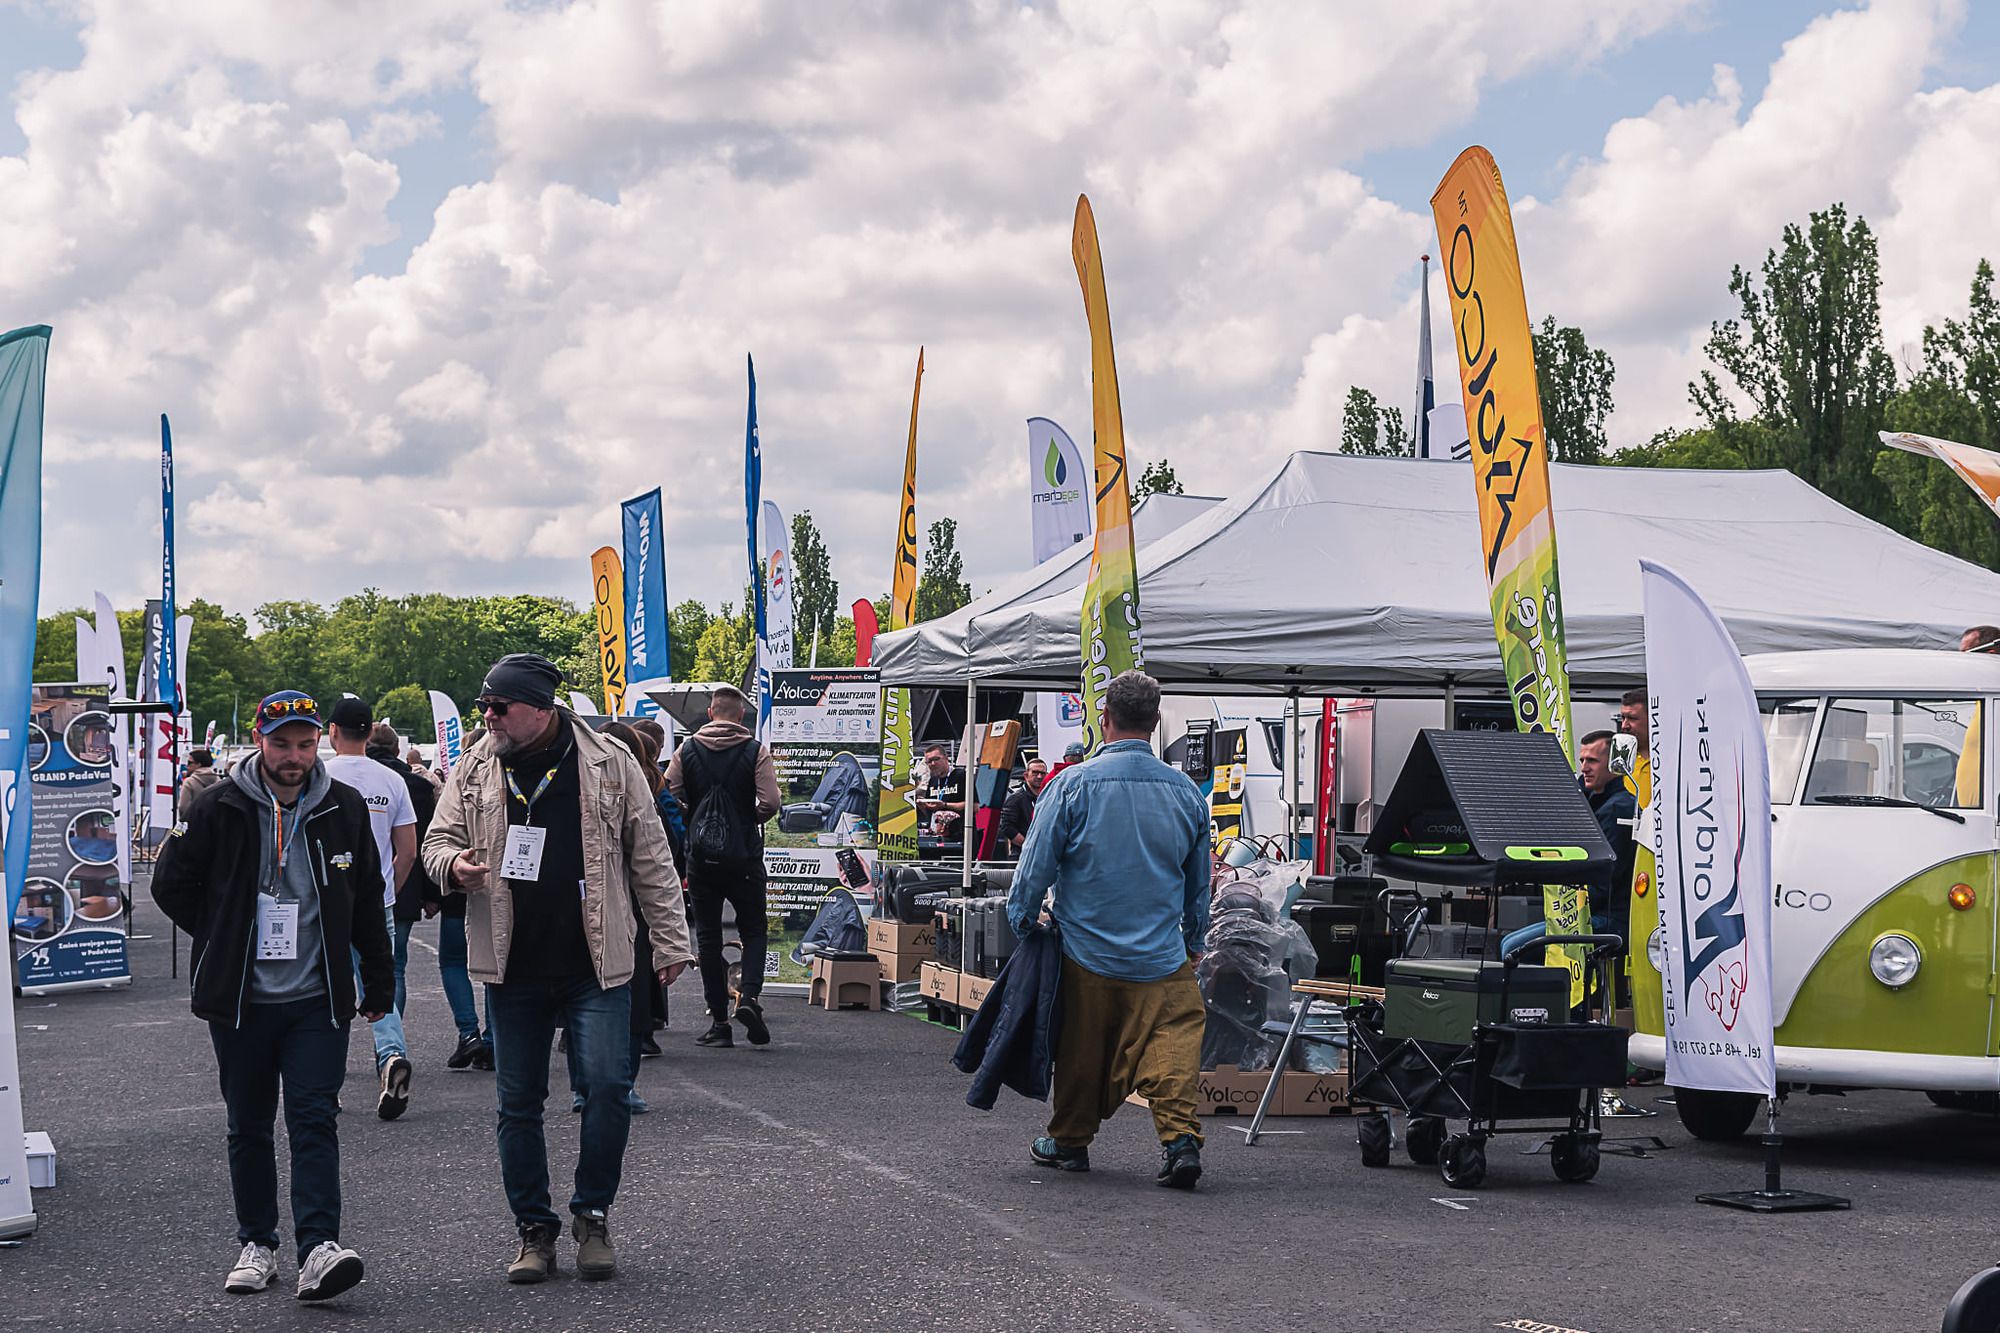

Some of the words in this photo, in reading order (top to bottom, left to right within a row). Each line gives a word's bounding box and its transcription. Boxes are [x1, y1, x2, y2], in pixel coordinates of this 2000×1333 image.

[782, 686, 821, 699] Yolco
[775, 708, 797, 716] TC590
[819, 749, 833, 757] jako
[32, 772, 66, 782] GRAND
[68, 770, 110, 780] PadaVan
[365, 795, 389, 806] e3D
[770, 863, 797, 874] 5000
[799, 863, 821, 874] BTU
[813, 884, 828, 892] jako
[1774, 884, 1832, 911] lco
[1204, 1085, 1260, 1103] Yolco
